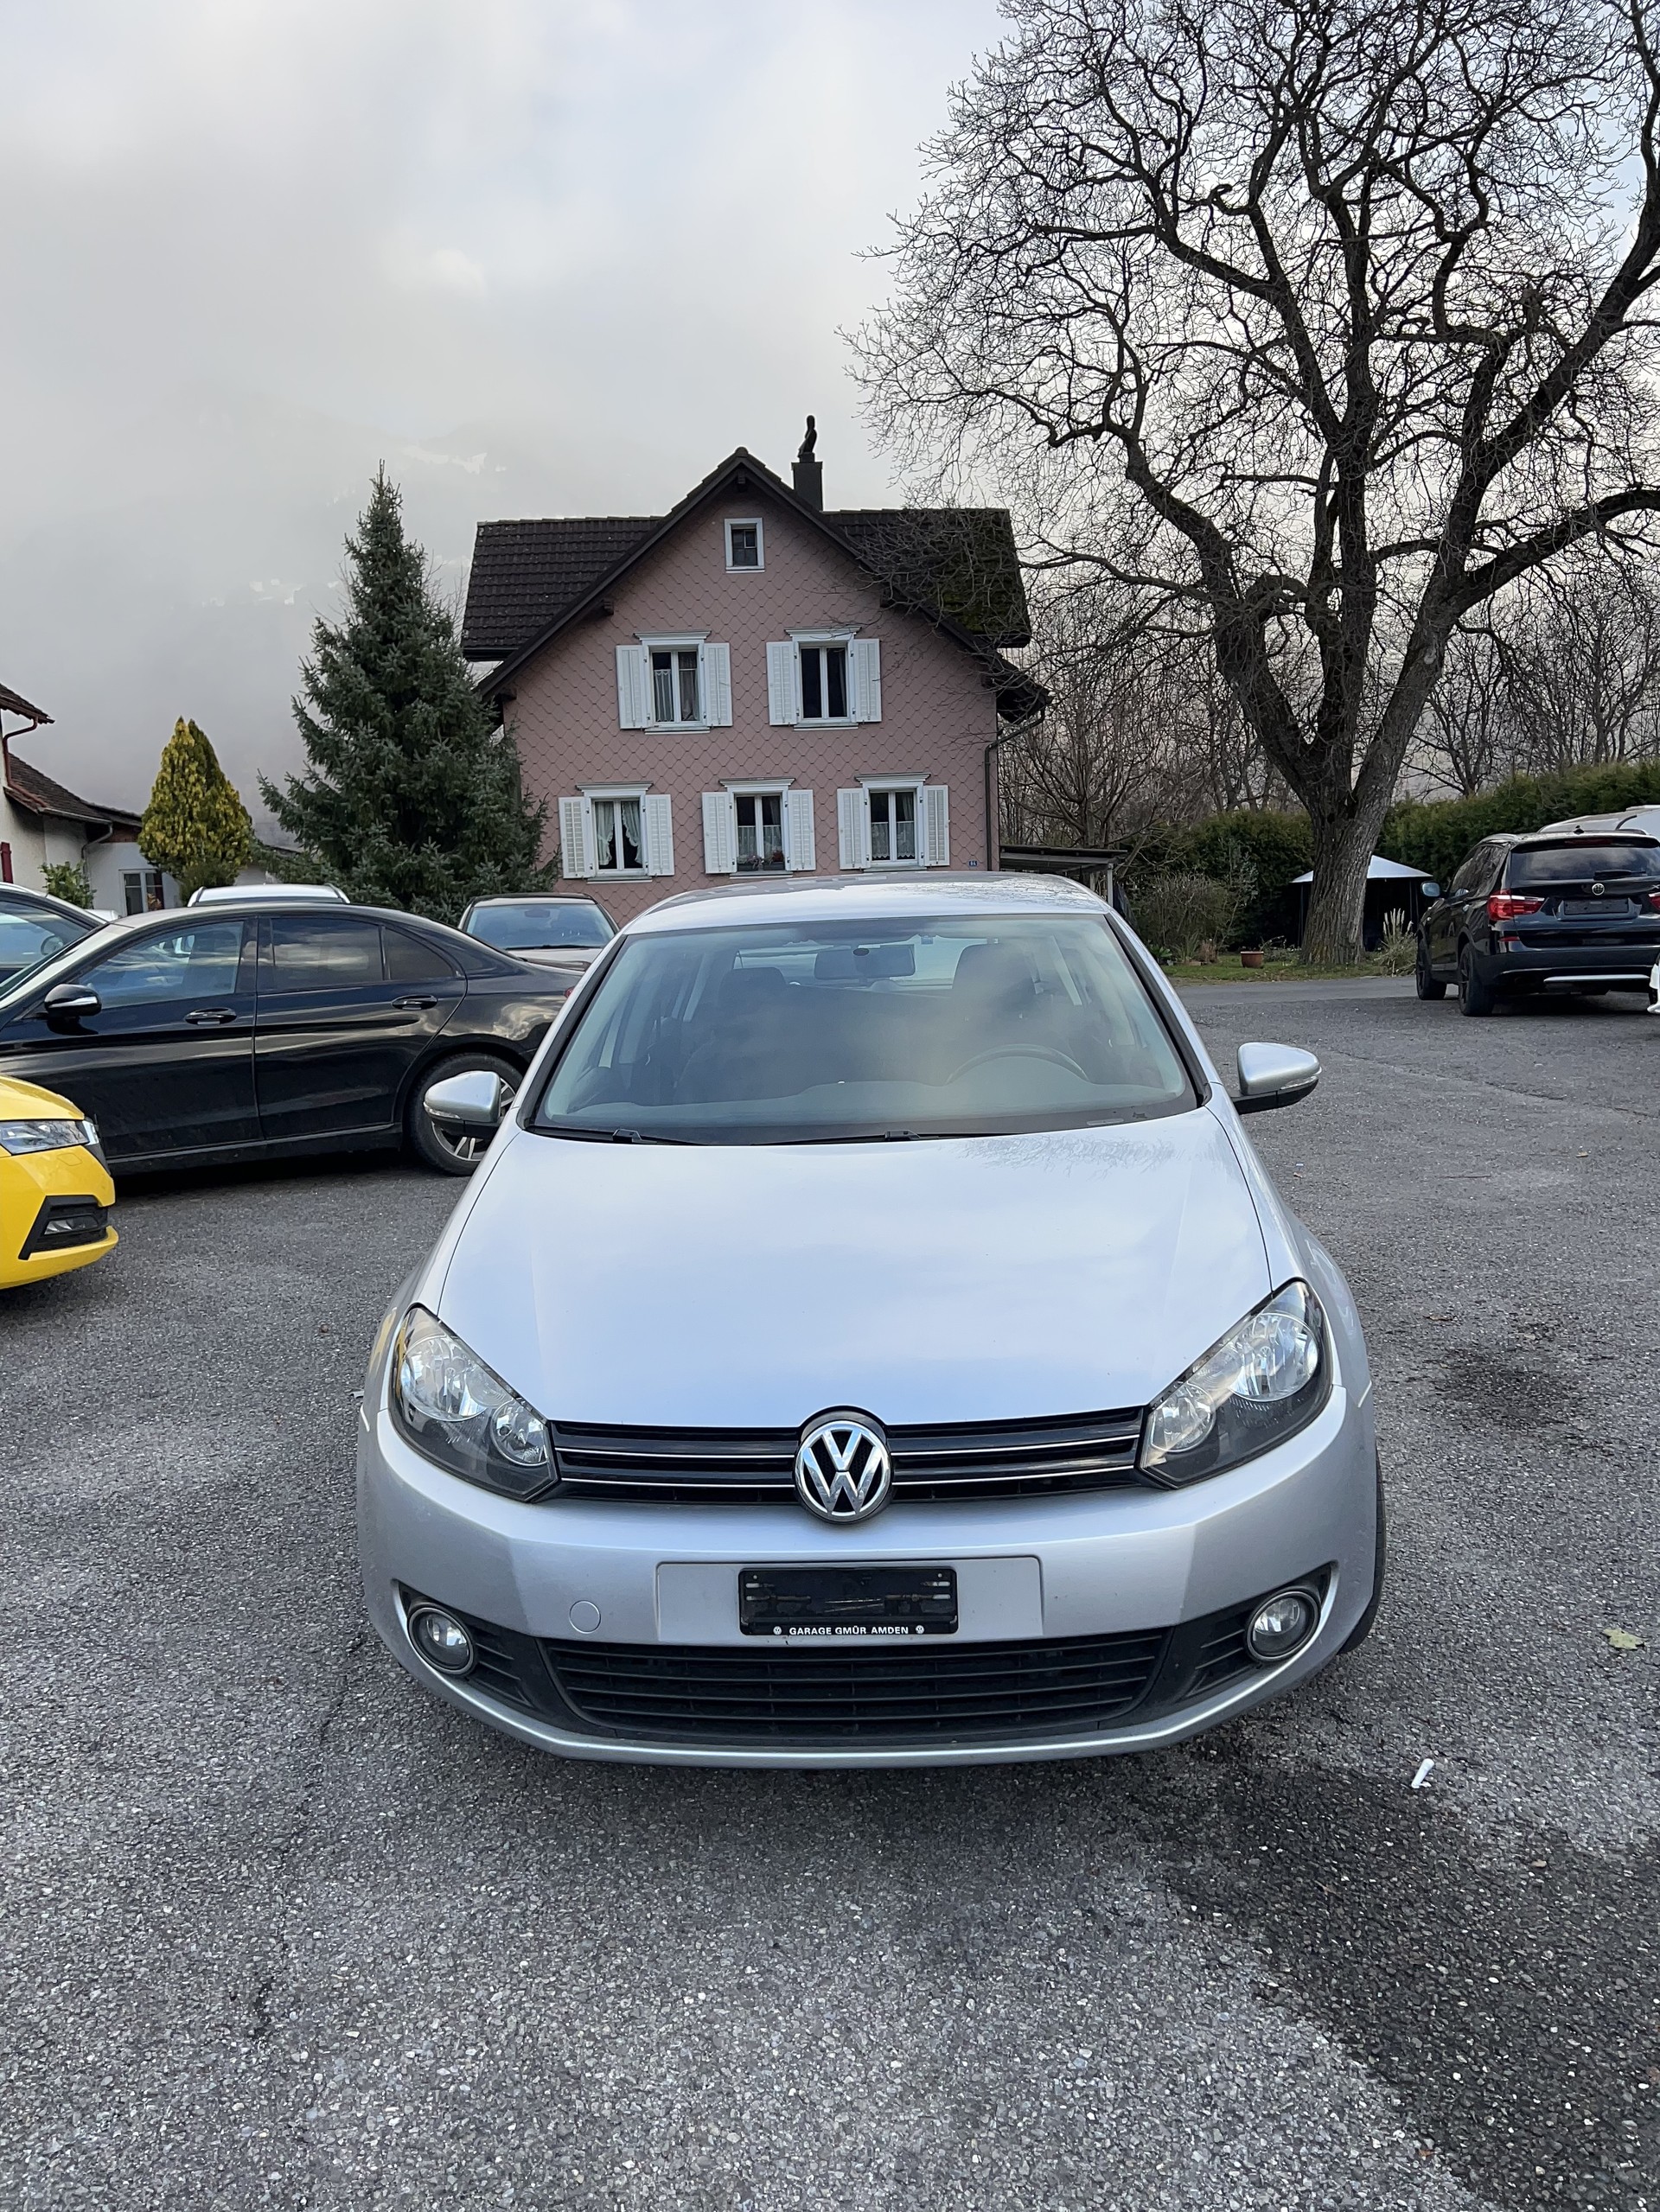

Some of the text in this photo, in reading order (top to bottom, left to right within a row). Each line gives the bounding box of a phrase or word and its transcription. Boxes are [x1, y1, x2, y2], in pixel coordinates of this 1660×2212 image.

[799, 1424, 886, 1518] VW
[788, 1627, 832, 1635] GARAGE
[834, 1625, 867, 1635] GMÜR
[871, 1626, 909, 1635] AMDEN
